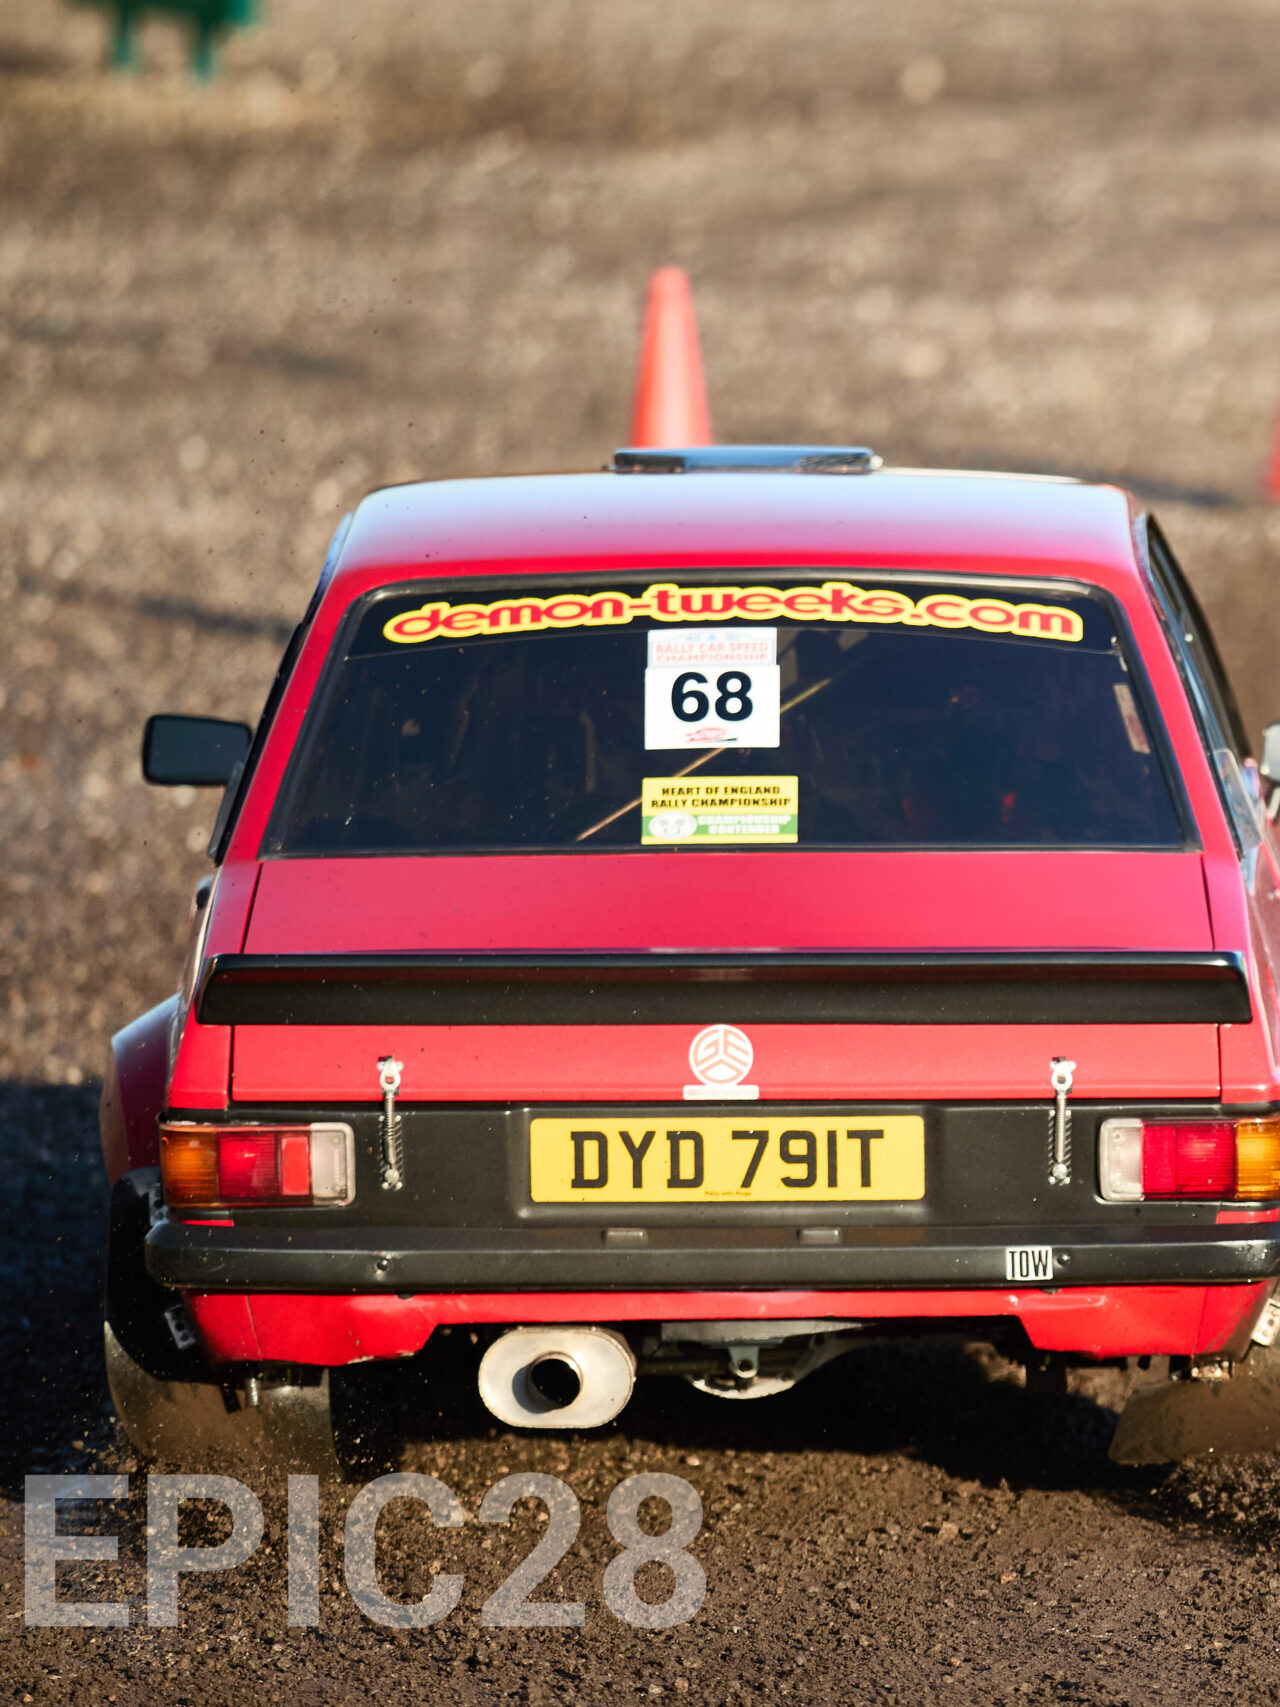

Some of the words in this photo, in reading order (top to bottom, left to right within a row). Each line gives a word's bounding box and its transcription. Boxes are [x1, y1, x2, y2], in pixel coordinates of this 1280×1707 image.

[384, 583, 1082, 643] demon-tweeks.com
[655, 643, 694, 655] RALLY
[698, 642, 725, 653] CAR
[729, 642, 768, 653] SPEED
[655, 653, 768, 664] CHAMPIONSHIP
[671, 671, 753, 722] 68
[662, 786, 701, 796] HEART
[705, 786, 720, 795] OF
[724, 785, 780, 795] ENGLAND
[651, 799, 688, 808] RALLY
[691, 798, 791, 808] CHAMPIONSHIP
[570, 1130, 704, 1189] DYD
[1009, 1250, 1049, 1278] TOW
